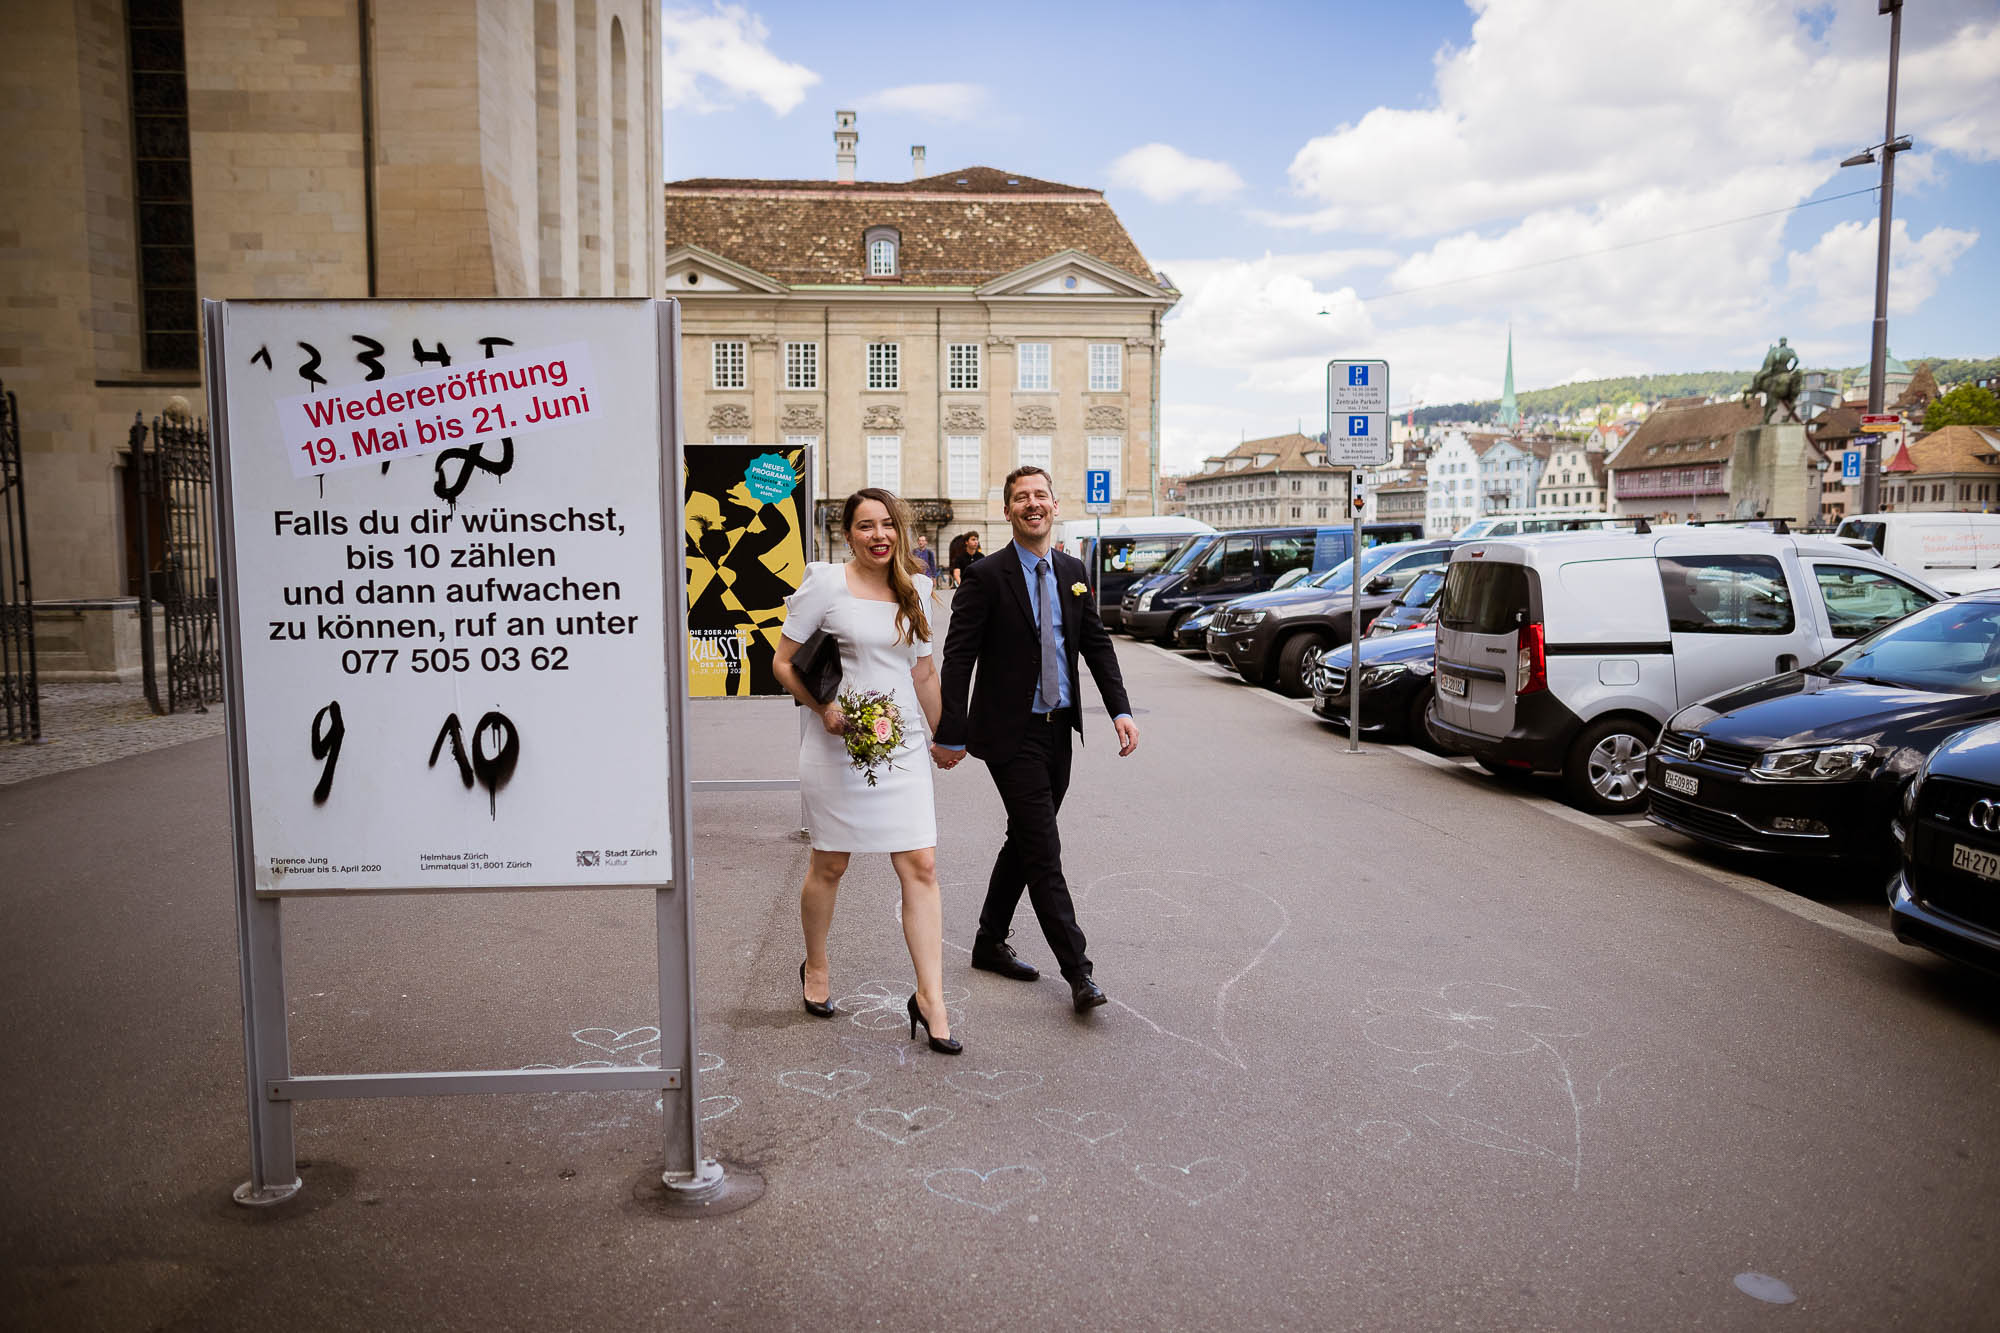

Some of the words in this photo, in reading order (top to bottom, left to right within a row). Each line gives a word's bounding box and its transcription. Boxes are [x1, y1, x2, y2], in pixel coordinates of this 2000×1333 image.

[251, 346, 272, 370] 1
[298, 342, 327, 386] 2
[352, 335, 385, 381] 3
[413, 339, 451, 367] 4
[1355, 367, 1363, 378] P
[304, 360, 568, 428] Wiedereröffnung
[302, 438, 346, 466] 19.
[352, 424, 408, 456] Mai
[416, 416, 464, 444] bis
[472, 404, 517, 434] 21.
[526, 387, 589, 423] Juni
[1354, 419, 1364, 434] P
[762, 462, 785, 473] NEUES
[1848, 454, 1856, 466] P
[752, 467, 792, 481] PROGRAMM
[1093, 472, 1105, 489] P
[765, 485, 782, 493] finden
[275, 511, 348, 535] Falls
[360, 510, 398, 534] du
[411, 508, 451, 534] dir
[462, 507, 625, 536] wünschst,
[347, 545, 393, 569] bis
[404, 544, 439, 568] 10
[451, 543, 555, 567] zählen
[284, 580, 343, 605] und
[356, 580, 435, 604] dann
[447, 577, 620, 602] aufwachen
[270, 622, 305, 640] zu
[318, 614, 445, 642] können,
[456, 612, 496, 636] ruf
[507, 617, 544, 636] an
[557, 612, 638, 635] unter
[689, 636, 747, 662] RAUSCH
[342, 650, 398, 674] 077
[412, 648, 469, 673] 505
[481, 647, 520, 671] 03
[531, 647, 568, 670] 62
[310, 700, 346, 806] 9
[428, 711, 520, 800] 10
[270, 857, 306, 865] Florence
[308, 857, 328, 865] Jung
[420, 853, 461, 861] Helmhaus
[463, 852, 489, 860] Zürich
[630, 849, 658, 857] Zürich
[284, 866, 315, 874] Februar
[317, 865, 330, 873] bis
[331, 865, 339, 873] 5.
[340, 865, 359, 873] April
[361, 864, 382, 872] 2020
[420, 863, 469, 871] Limmatquai
[470, 862, 483, 870] 31,
[506, 861, 532, 869] Zürich
